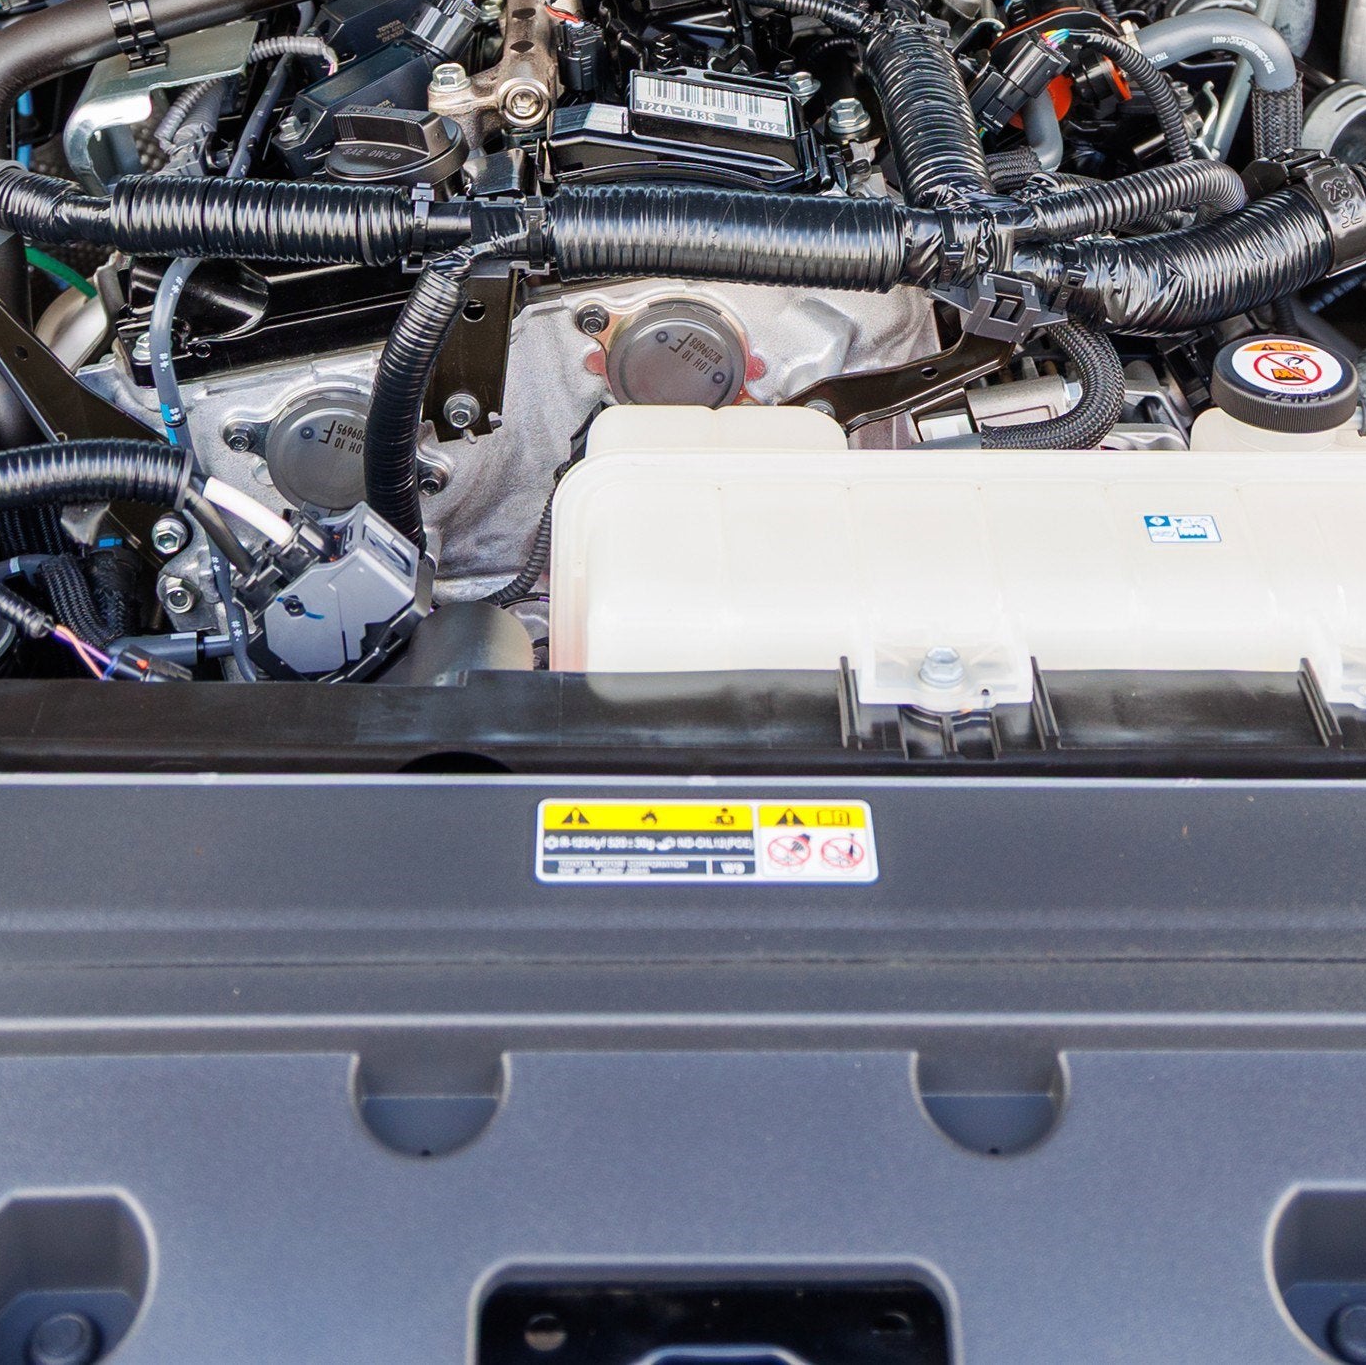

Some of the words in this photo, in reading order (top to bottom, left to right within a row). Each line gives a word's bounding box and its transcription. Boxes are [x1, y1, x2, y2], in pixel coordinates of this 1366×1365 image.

[637, 100, 716, 123] T24A-T83S
[341, 147, 365, 157] SAE
[368, 149, 402, 161] 0W-20
[669, 332, 693, 353] F
[318, 420, 337, 444] F
